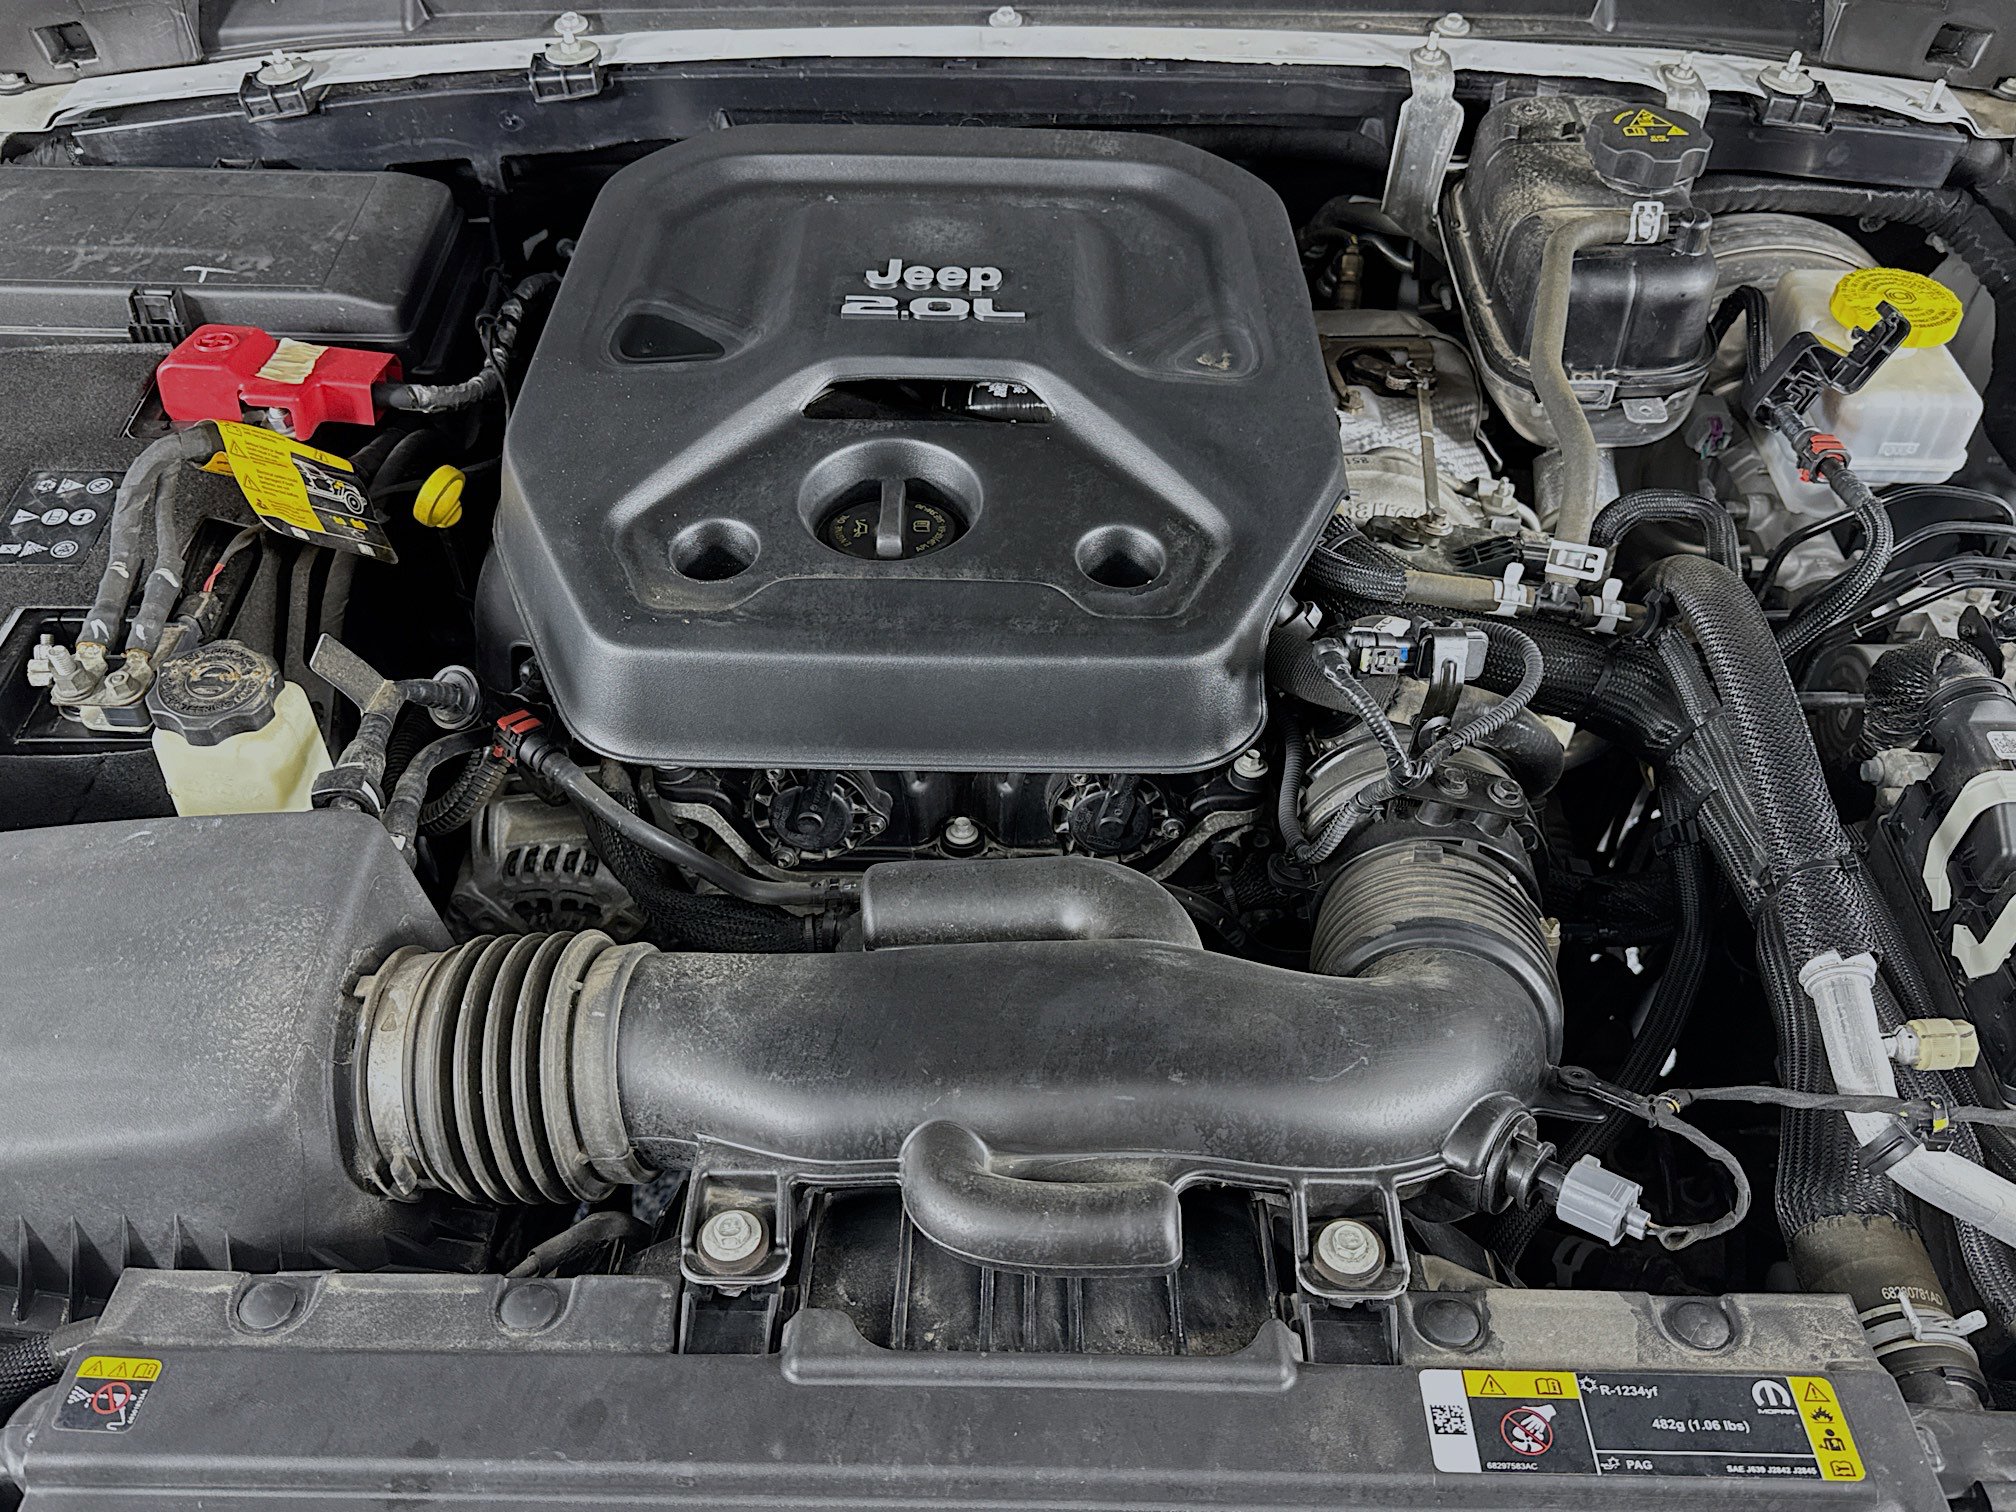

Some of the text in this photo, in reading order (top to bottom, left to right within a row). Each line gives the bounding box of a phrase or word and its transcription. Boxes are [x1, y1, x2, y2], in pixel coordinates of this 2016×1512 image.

[865, 258, 1003, 296] Jeep
[841, 295, 1026, 323] 2.0L
[1600, 1385, 1658, 1398] R-1234yf
[1652, 1418, 1750, 1433] 482g (1.06 lbs)
[1486, 1462, 1538, 1470] 68297583AC
[1626, 1460, 1653, 1470] PAG
[1726, 1465, 1745, 1473] SAE
